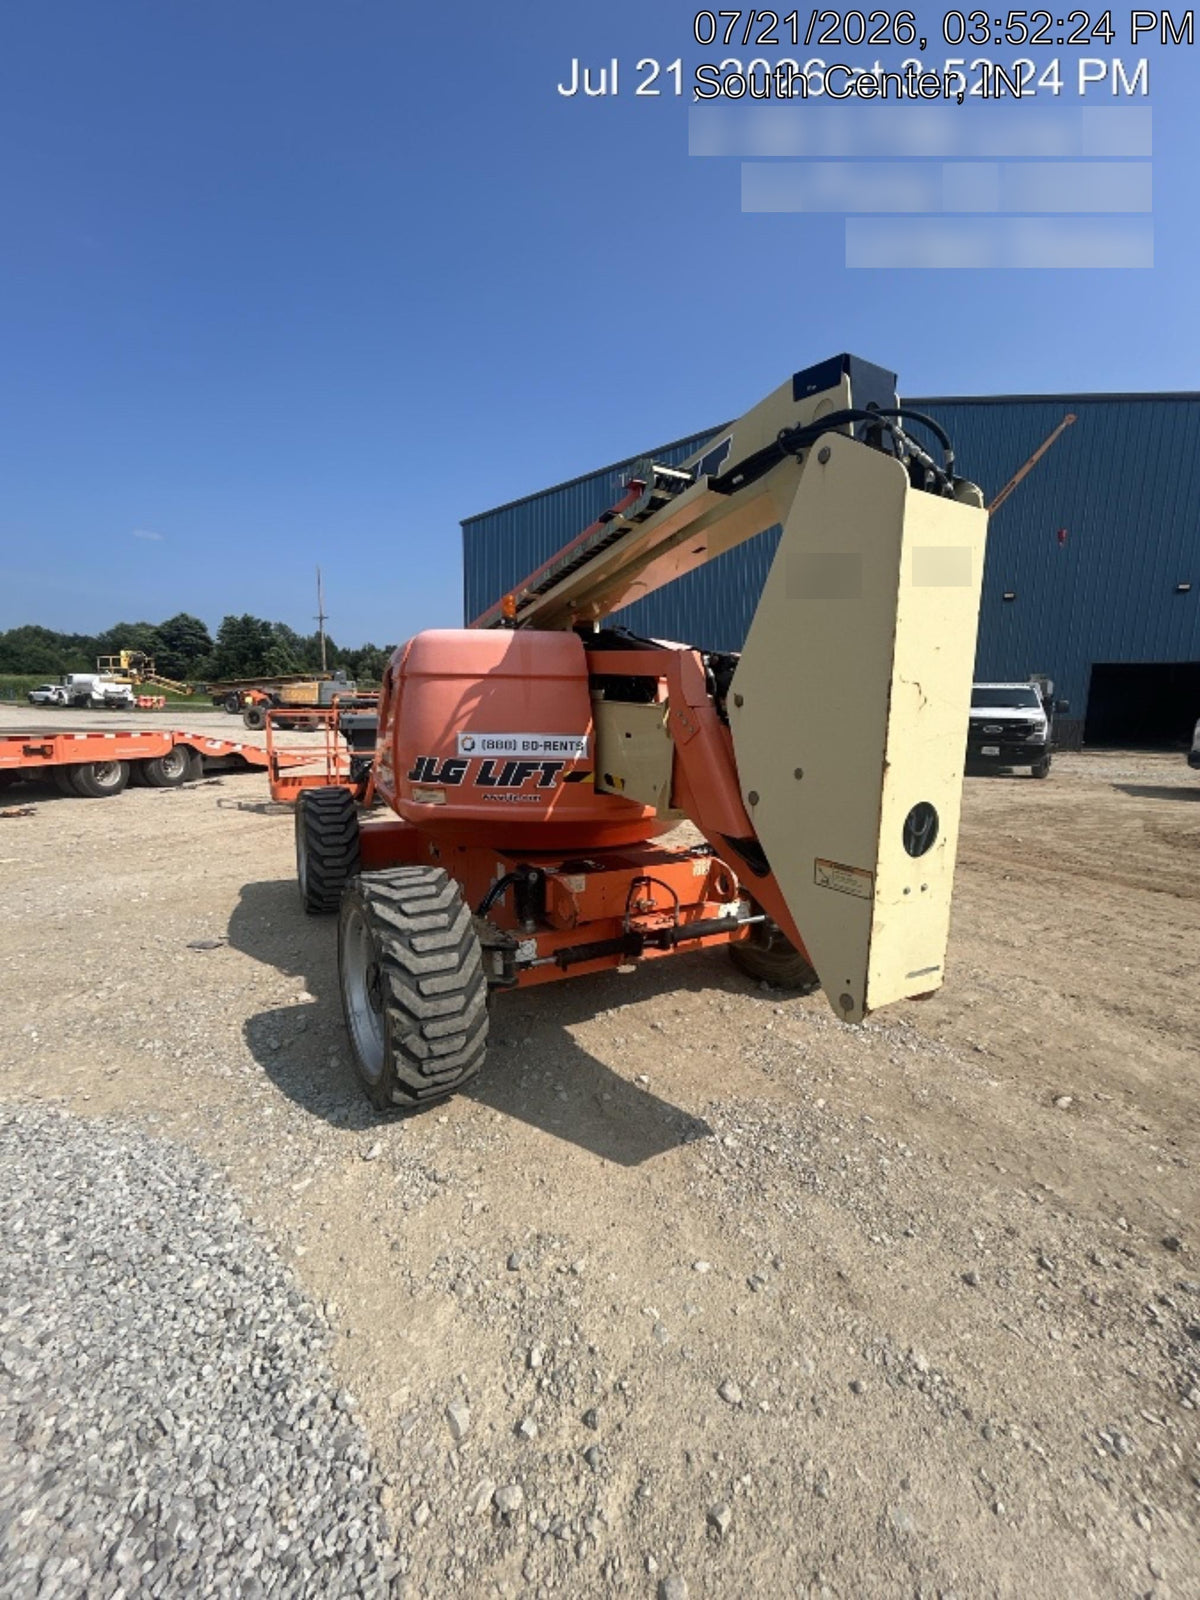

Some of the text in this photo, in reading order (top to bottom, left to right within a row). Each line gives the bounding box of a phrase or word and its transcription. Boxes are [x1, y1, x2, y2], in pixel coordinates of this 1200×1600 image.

[521, 740, 585, 752] BD-RENTS
[408, 756, 566, 788] JLG LIFT
